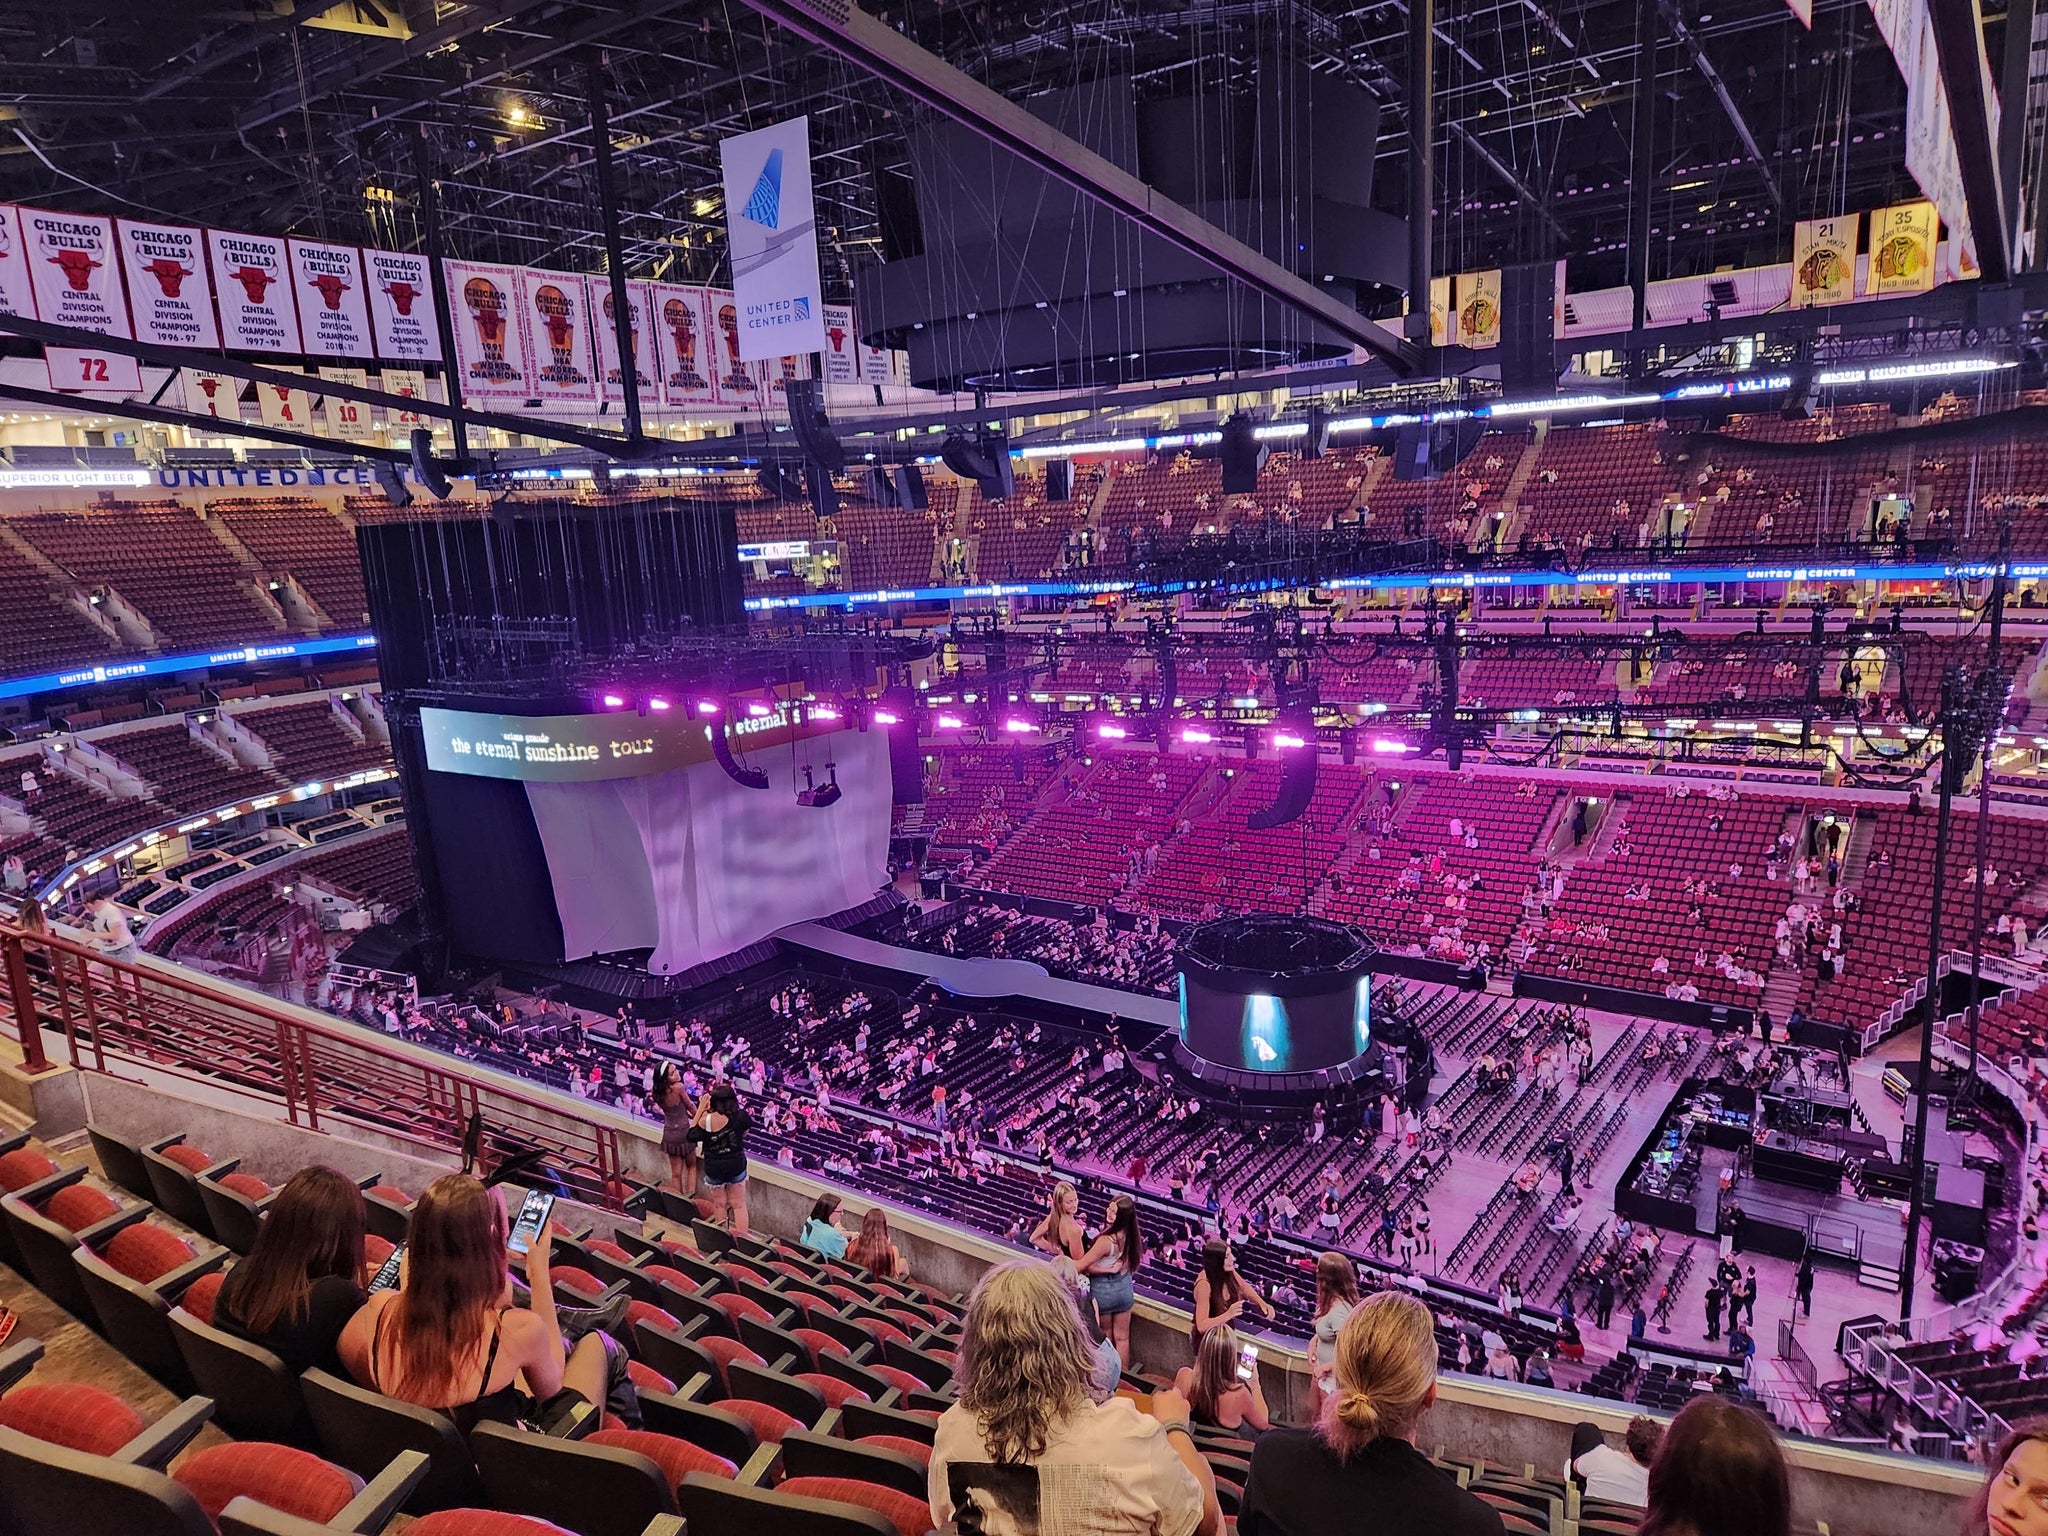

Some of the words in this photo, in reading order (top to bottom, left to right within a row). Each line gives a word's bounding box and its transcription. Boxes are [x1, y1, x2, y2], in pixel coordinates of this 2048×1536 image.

[1895, 211, 1913, 225] 35
[34, 219, 101, 236] CHICAGO
[1820, 223, 1834, 237] 21
[1896, 225, 1930, 239] ESPOSITO
[47, 235, 96, 249] BULLS
[131, 230, 192, 245] CHICAGO
[143, 245, 187, 258] BULLS
[220, 239, 276, 254] CHICAGO
[1802, 241, 1820, 255] STAN
[1826, 239, 1848, 250] MIKITA
[231, 253, 271, 266] BULLS
[300, 248, 350, 263] CHICAGO
[310, 262, 345, 275] BULLS
[374, 257, 421, 271] CHICAGO
[383, 270, 417, 281] BULLS
[62, 291, 101, 301] CENTRAL
[466, 288, 506, 300] CHICAGO
[1484, 290, 1498, 298] HULL
[154, 300, 190, 309] CENTRAL
[474, 300, 502, 309] BULLS
[538, 295, 574, 307] CHICAGO
[62, 302, 104, 312] DIVISION
[242, 306, 274, 315] CENTRAL
[546, 306, 570, 316] BULLS
[747, 300, 790, 315] UNITED
[57, 314, 112, 324] CHAMPIONS
[155, 312, 193, 321] DIVISION
[242, 316, 277, 326] DIVISION
[320, 312, 349, 321] CENTRAL
[749, 315, 791, 328] CENTER
[150, 321, 200, 332] CHAMPIONS
[321, 322, 352, 331] DIVISION
[393, 318, 420, 326] CENTRAL
[238, 326, 285, 336] CHAMPIONS
[317, 332, 359, 342] CHAMPIONS
[482, 342, 502, 351] 1991
[485, 352, 503, 360] NBA
[554, 356, 570, 364] NBA
[79, 358, 109, 381] 72
[480, 362, 511, 370] WORLD
[1300, 360, 1333, 369] UNITED
[548, 366, 577, 374] WORLD
[470, 371, 522, 380] CHAMPIONS
[540, 375, 588, 384] CHAMPIONS
[669, 381, 708, 389] CHAMPIONS
[281, 404, 293, 421] 4
[340, 406, 357, 422] 10
[65, 473, 100, 482] LIGHT
[104, 473, 134, 482] BEER
[159, 469, 299, 488] UNITED
[1577, 574, 1616, 582] UNITED
[1630, 572, 1671, 581] CENTER
[1747, 571, 1791, 579] UNITED
[1808, 569, 1855, 577] CENTER
[964, 588, 992, 596] UNITED
[1001, 586, 1028, 594] CENTER
[849, 594, 877, 602] UNITED
[887, 591, 915, 600] CENTER
[210, 652, 245, 663] UNITED
[256, 646, 296, 658] CENTER
[60, 672, 94, 684] UNITED
[106, 664, 146, 677] CENTER
[736, 709, 788, 735] eternal
[503, 733, 523, 742] ariana
[525, 733, 549, 743] grande
[452, 737, 471, 754] the
[476, 742, 520, 760] eternal
[525, 743, 599, 762] sunshine
[610, 738, 654, 758] tour
